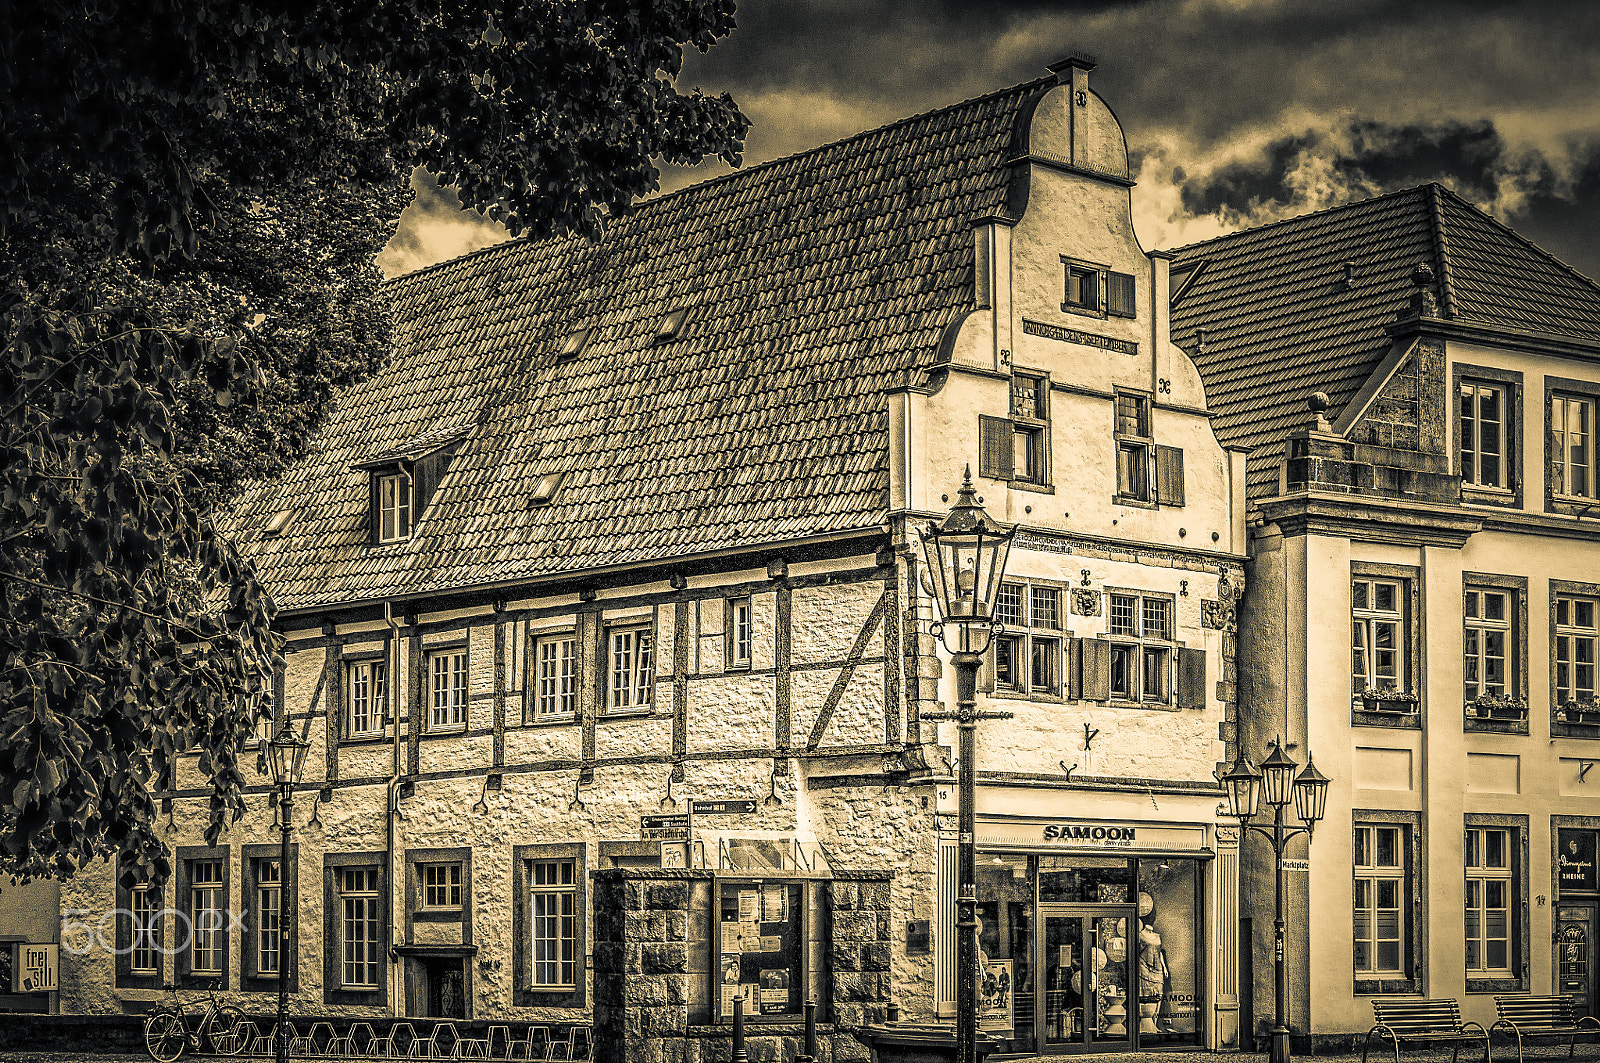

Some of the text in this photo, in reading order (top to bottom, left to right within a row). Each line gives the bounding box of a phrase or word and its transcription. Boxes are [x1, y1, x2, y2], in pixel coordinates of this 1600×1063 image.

[938, 790, 947, 800] 15
[1043, 825, 1136, 841] SAMOON
[1282, 860, 1309, 870] Marktplatz
[26, 947, 48, 967] frei
